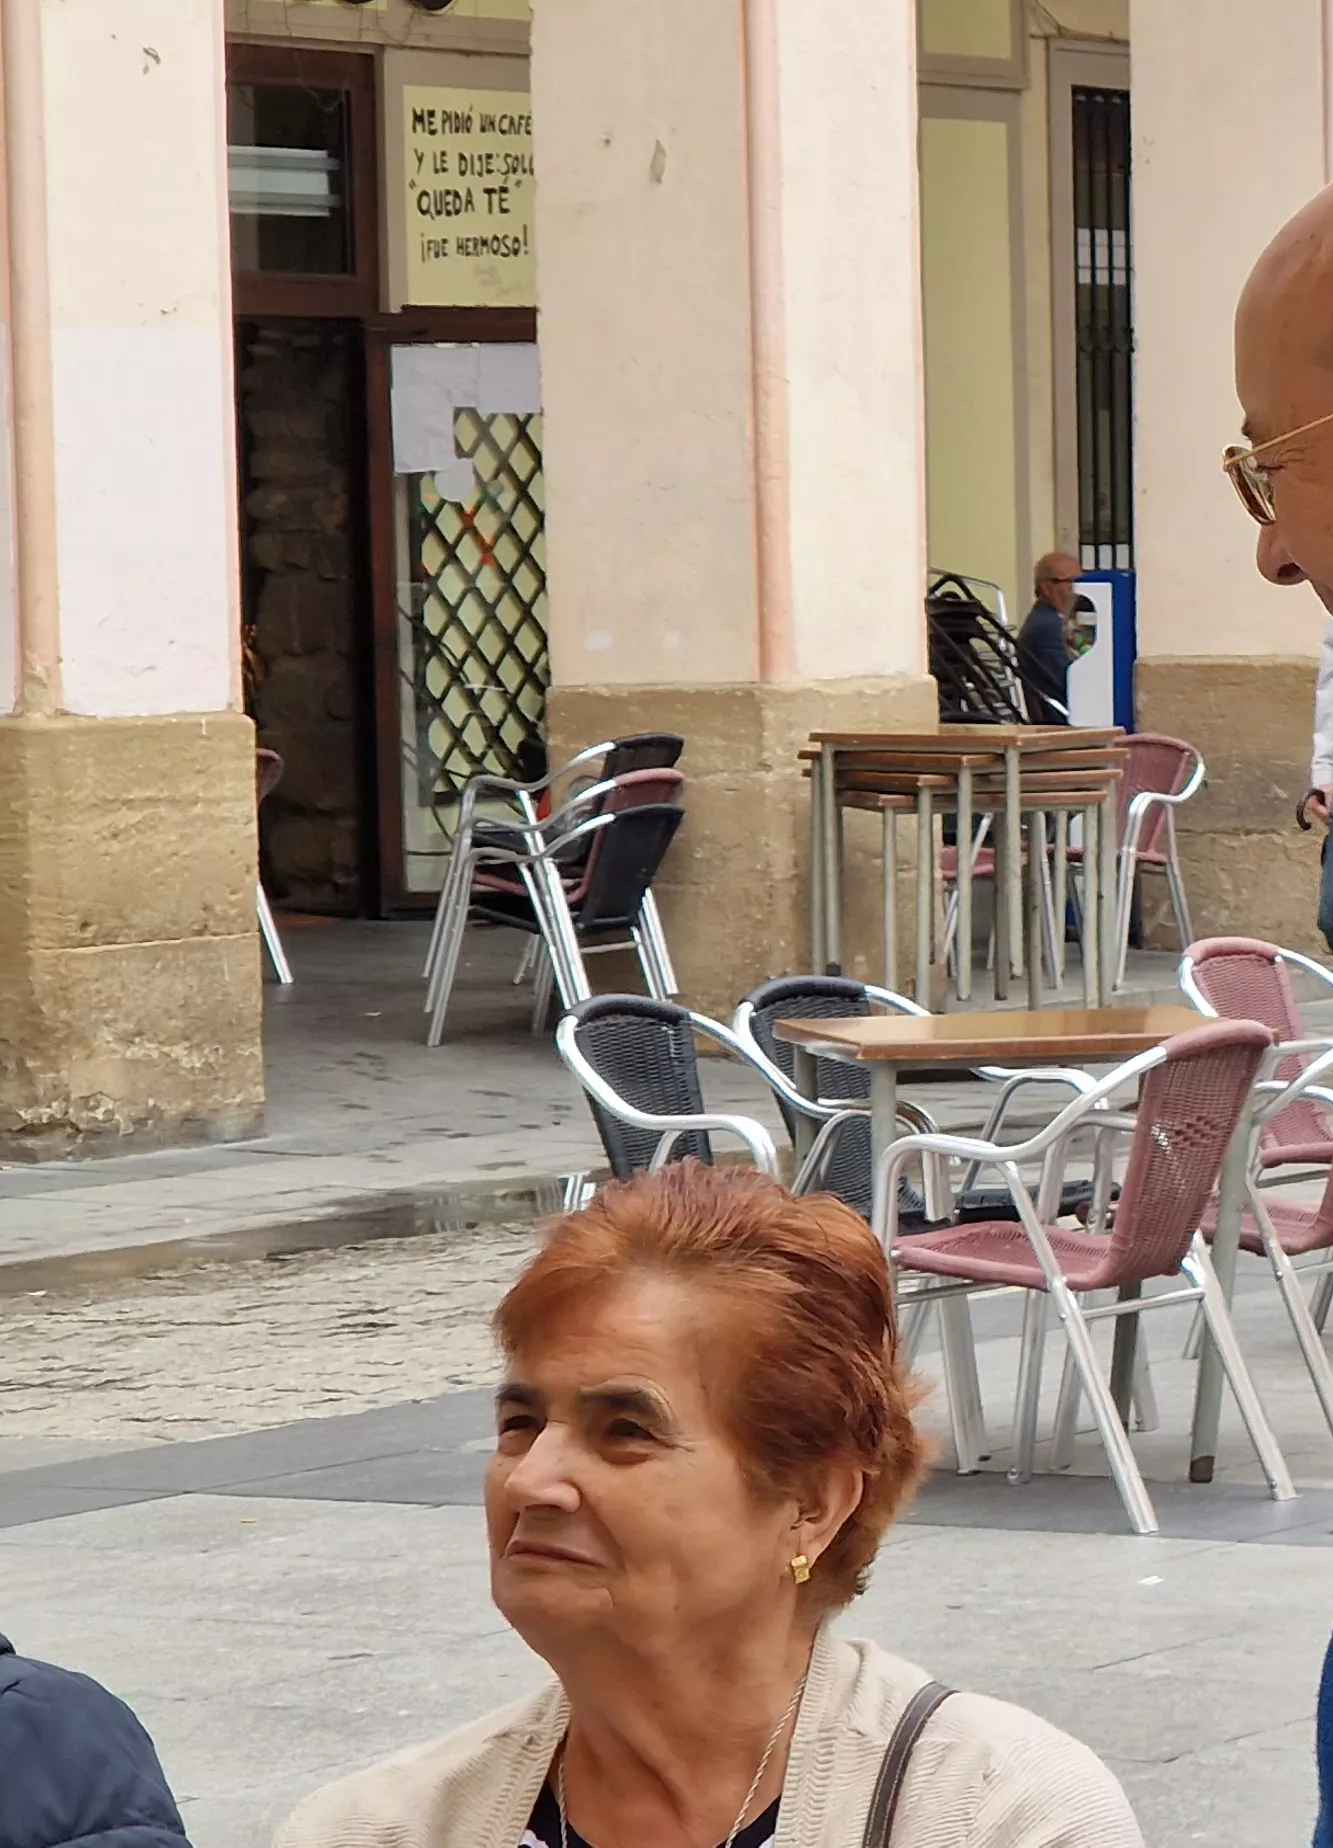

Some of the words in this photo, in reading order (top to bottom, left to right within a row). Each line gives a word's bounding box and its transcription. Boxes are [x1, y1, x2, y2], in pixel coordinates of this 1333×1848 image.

[412, 106, 438, 136] ME
[441, 103, 473, 135] PIDIÓ
[479, 112, 496, 134] UN
[413, 147, 424, 175] Y
[433, 150, 449, 175] LE
[456, 223, 529, 258] HERMOSO!
